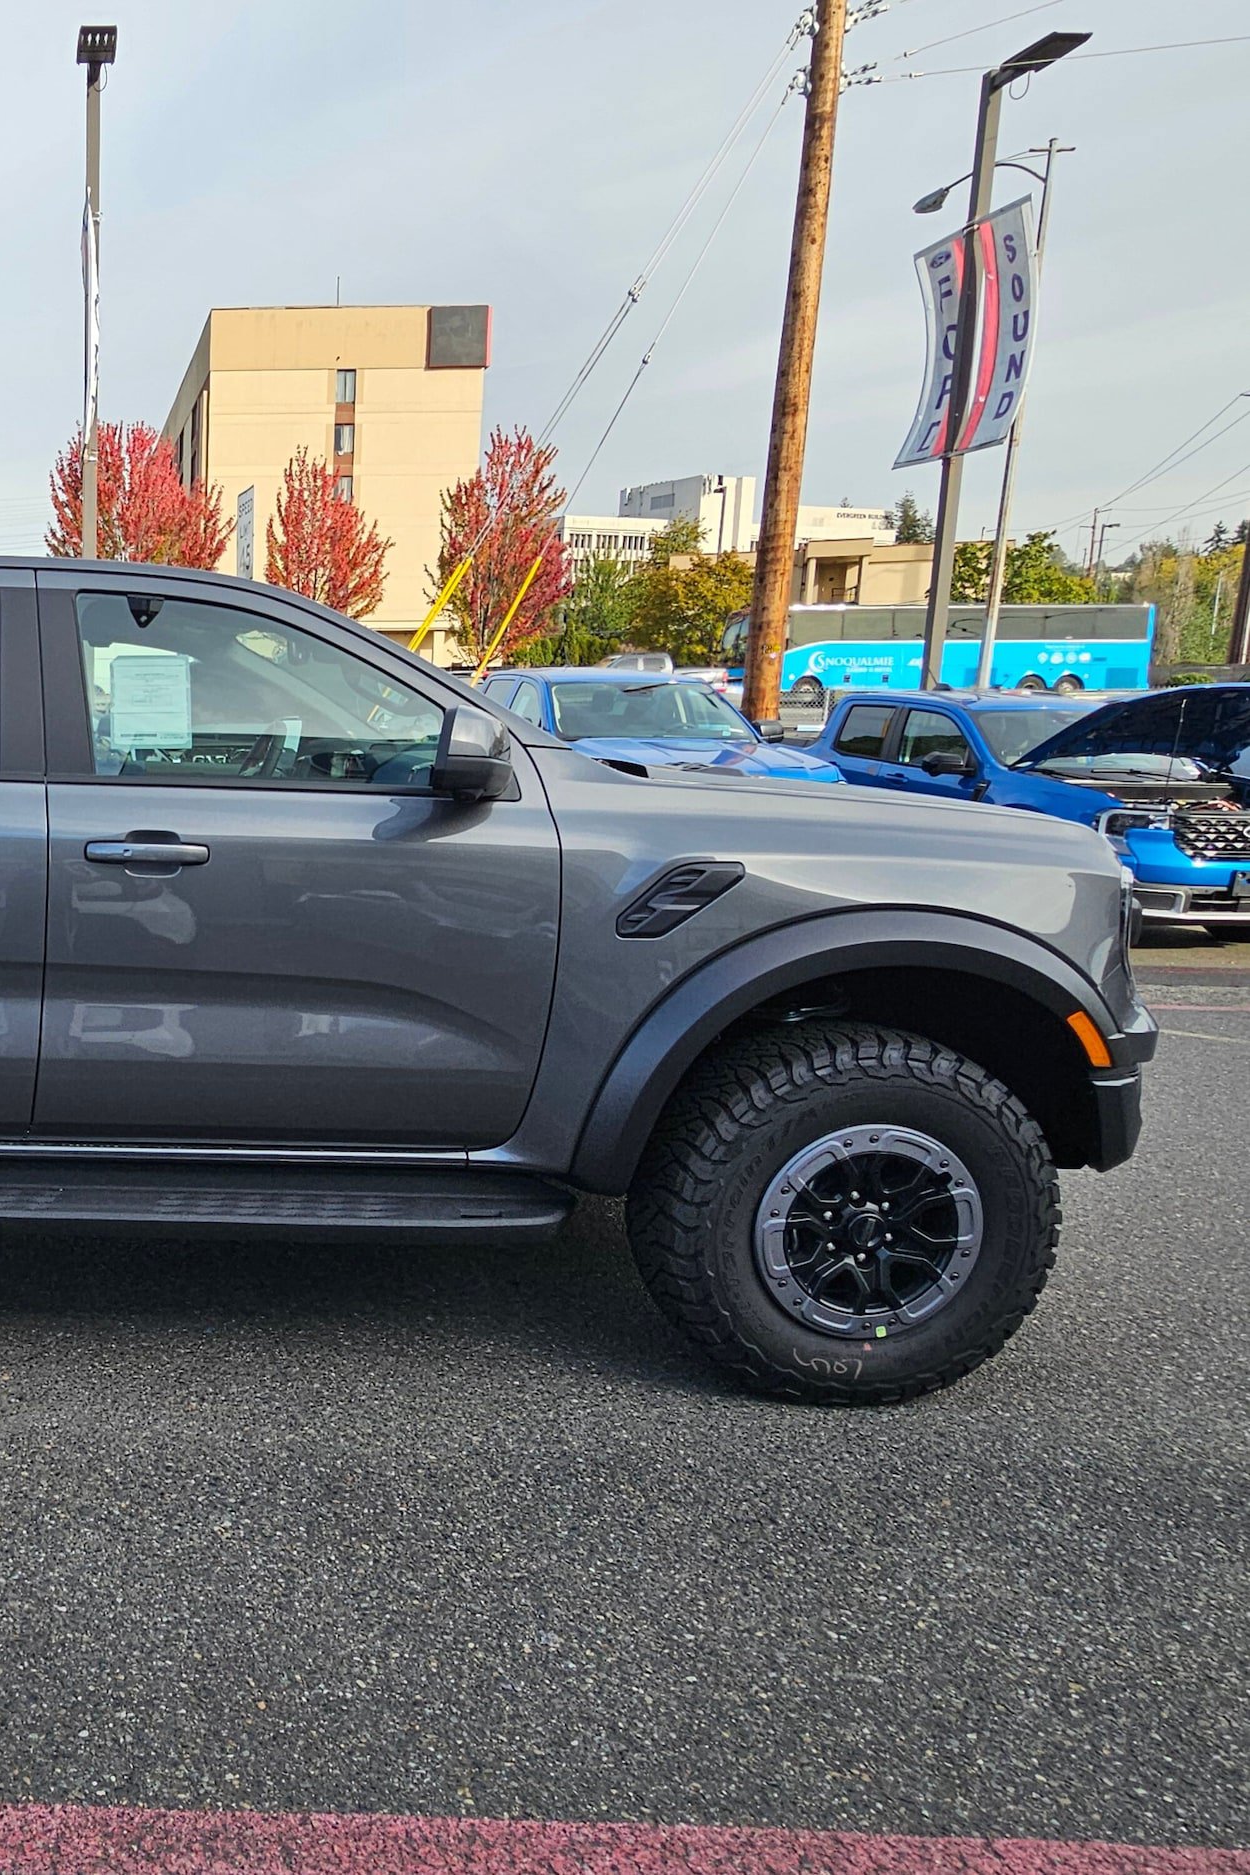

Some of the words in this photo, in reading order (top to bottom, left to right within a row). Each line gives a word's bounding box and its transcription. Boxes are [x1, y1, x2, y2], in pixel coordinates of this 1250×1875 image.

[993, 234, 1029, 421] SOUND
[238, 498, 253, 518] SPEED
[817, 652, 894, 669] SNOQUALMIE
